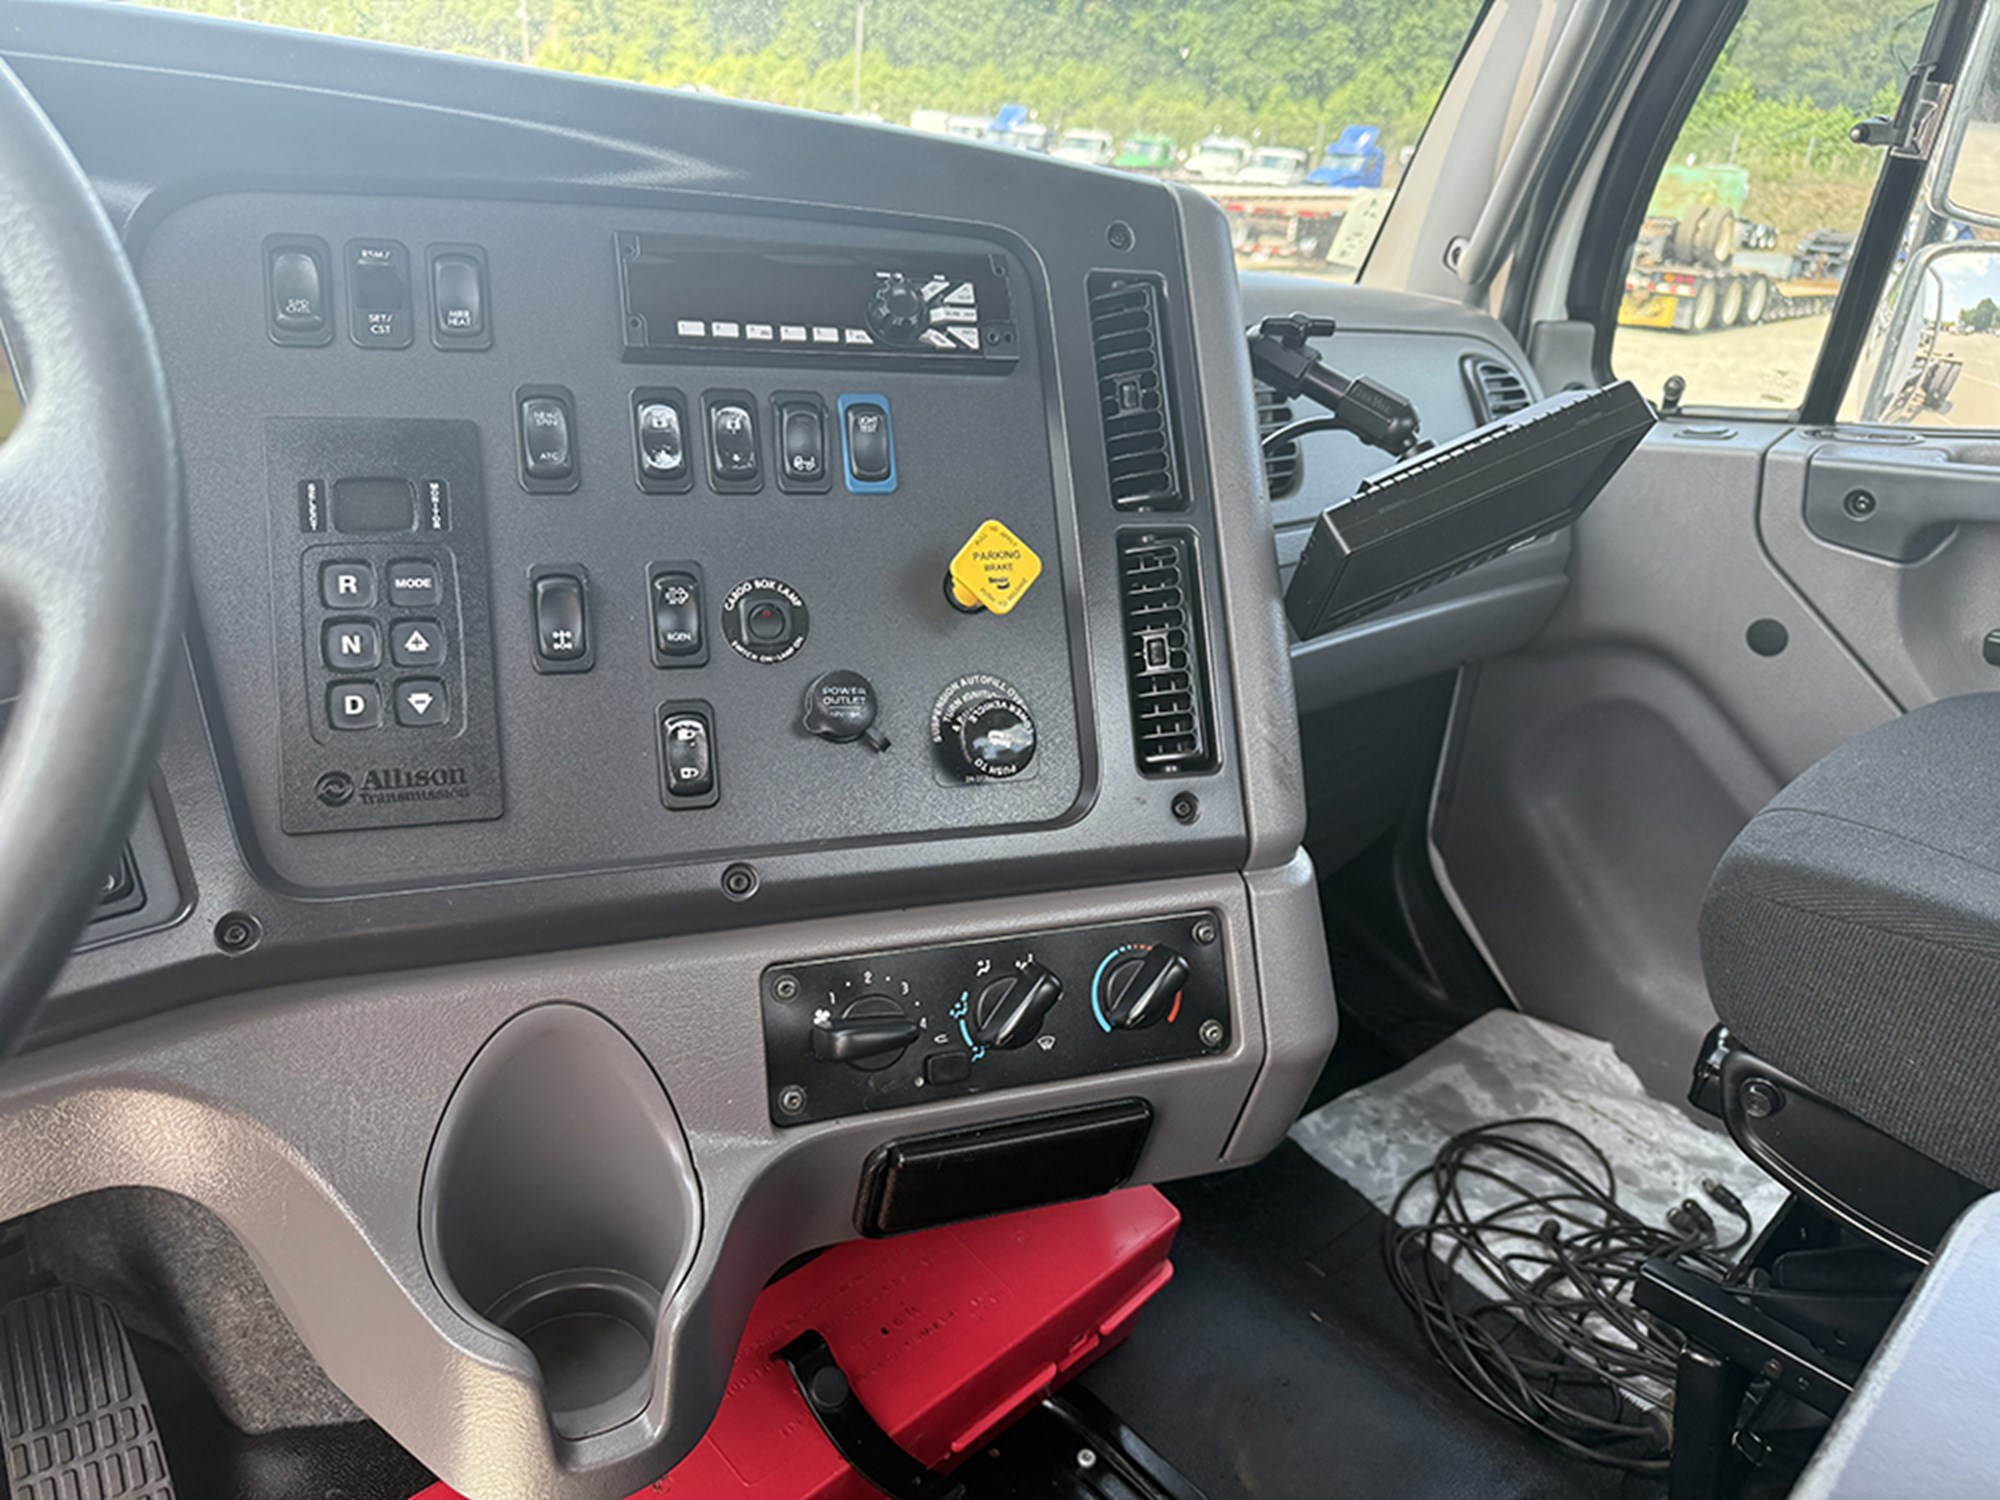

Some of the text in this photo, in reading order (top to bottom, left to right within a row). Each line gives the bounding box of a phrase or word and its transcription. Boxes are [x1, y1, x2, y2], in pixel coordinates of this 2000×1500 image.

[447, 318, 471, 326] HEAT
[972, 550, 1021, 561] PARKING
[984, 563, 1014, 572] BRAKE
[338, 575, 358, 594] R
[395, 578, 432, 589] MODE
[753, 579, 777, 590] BOX
[777, 584, 803, 607] LAMP
[341, 634, 362, 654] N
[822, 686, 867, 695] POWER
[344, 695, 365, 715] D
[822, 696, 867, 705] OUTLET
[360, 767, 468, 790] Allison
[863, 971, 873, 984] 2
[901, 981, 909, 995] 3
[829, 991, 836, 1004] 1
[919, 1017, 927, 1029] 4
